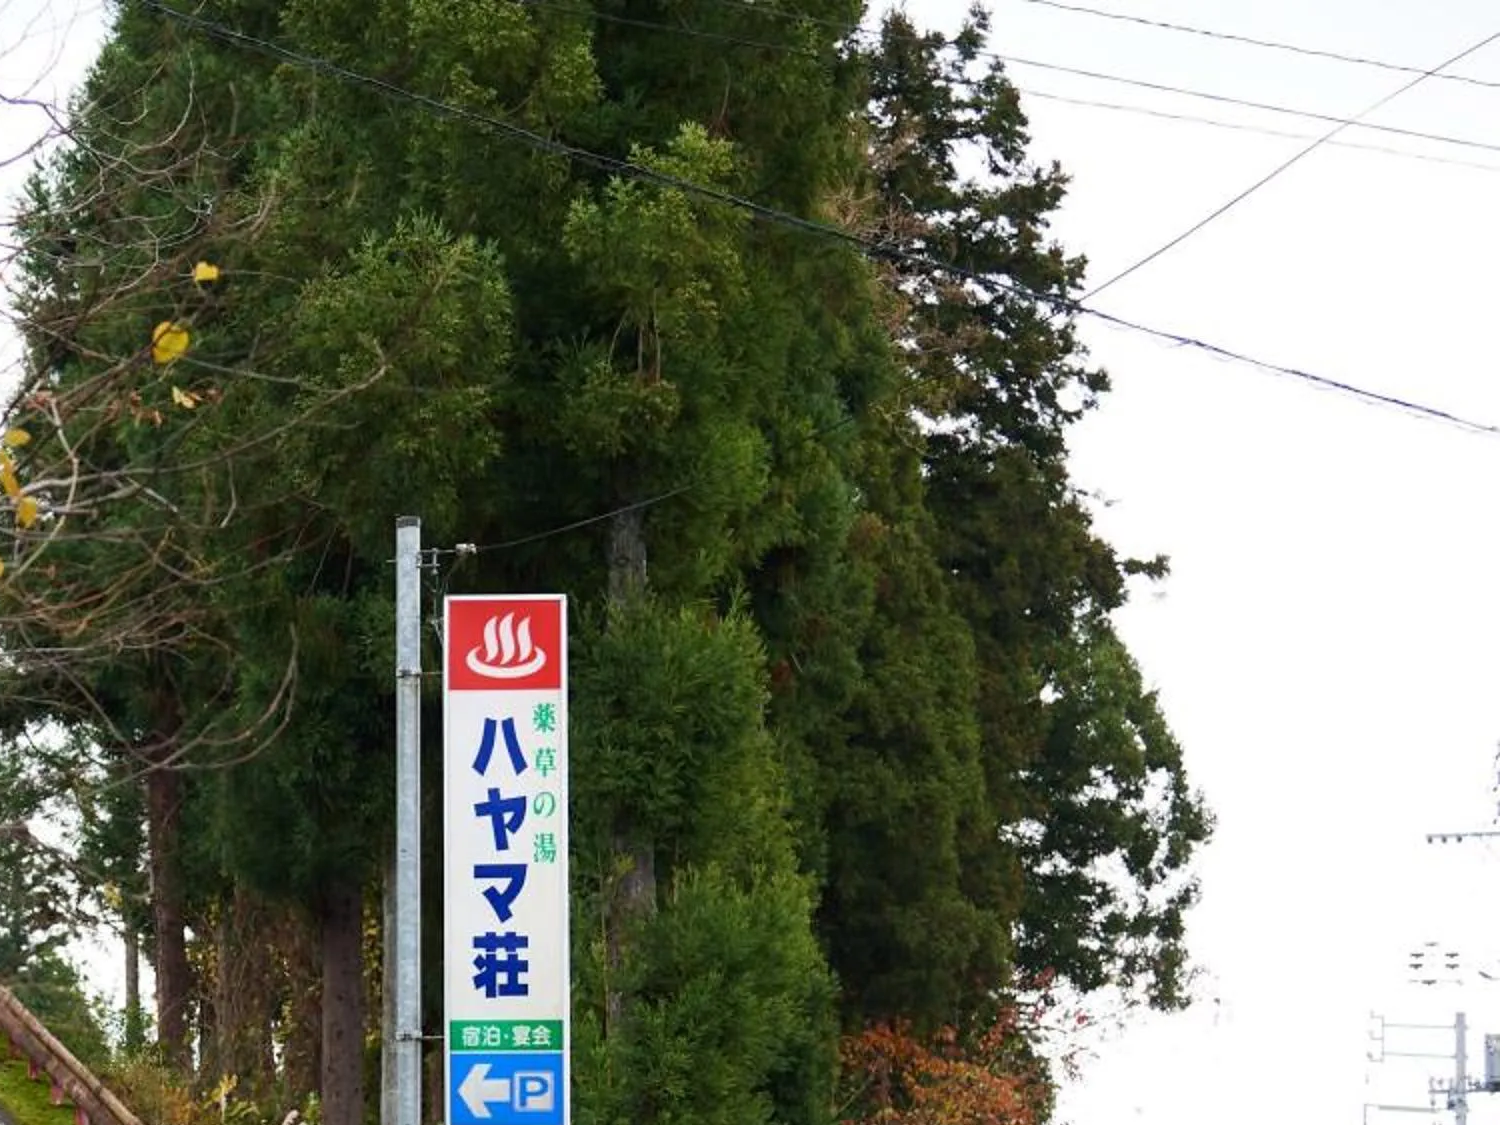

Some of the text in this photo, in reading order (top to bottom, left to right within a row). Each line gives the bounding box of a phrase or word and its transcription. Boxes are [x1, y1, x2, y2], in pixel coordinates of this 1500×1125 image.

[472, 717, 528, 998] ハヤマ荘
[533, 703, 556, 862] 薬草の湯
[519, 1076, 549, 1107] P
